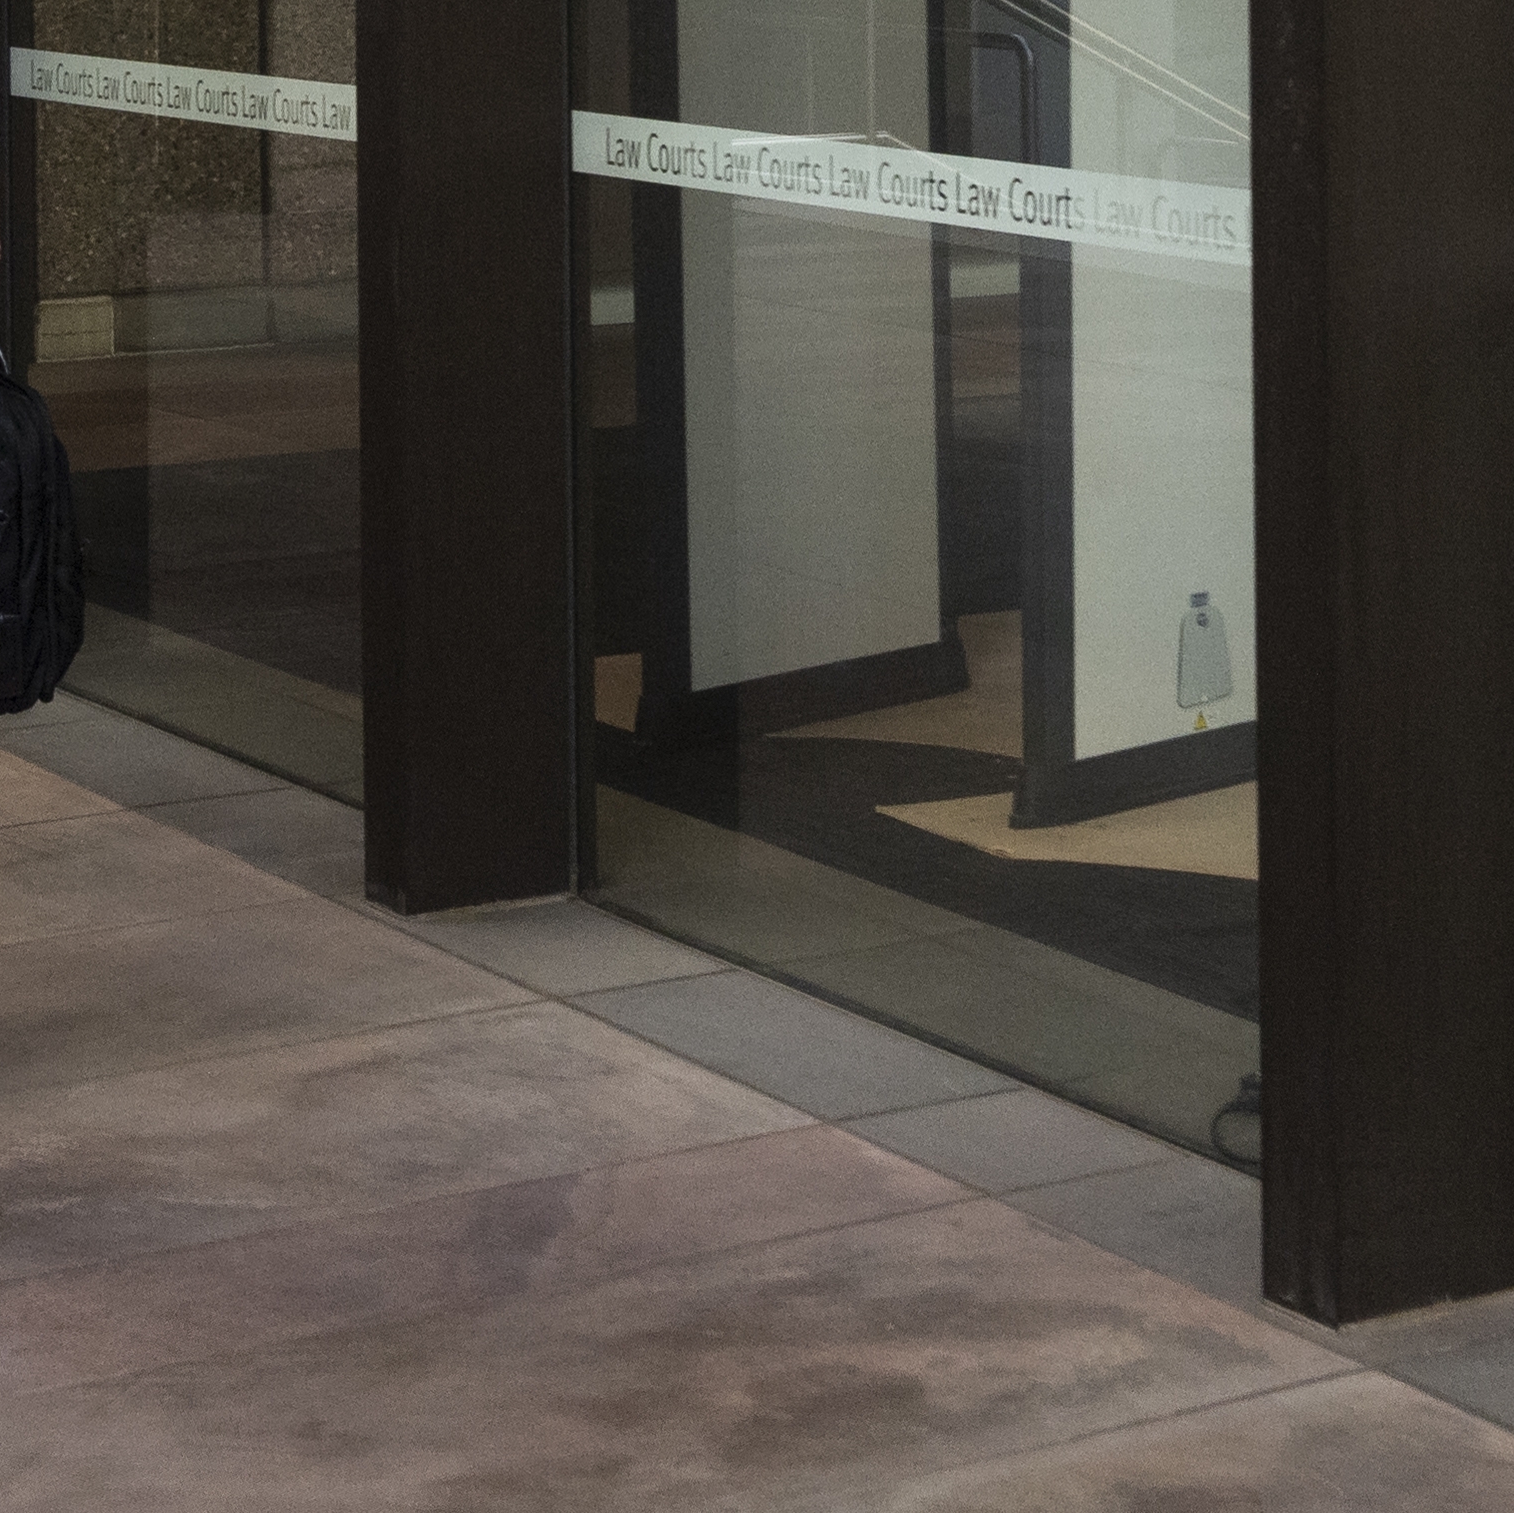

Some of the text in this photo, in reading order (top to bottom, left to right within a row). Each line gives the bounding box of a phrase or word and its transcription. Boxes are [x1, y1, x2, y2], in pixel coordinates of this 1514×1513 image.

[30, 59, 352, 131] Law Courts Law Courts Law Courts Law Courts Law
[606, 127, 1236, 250] Law Courts Law Courts Law Courts Law Courts Law Courts
